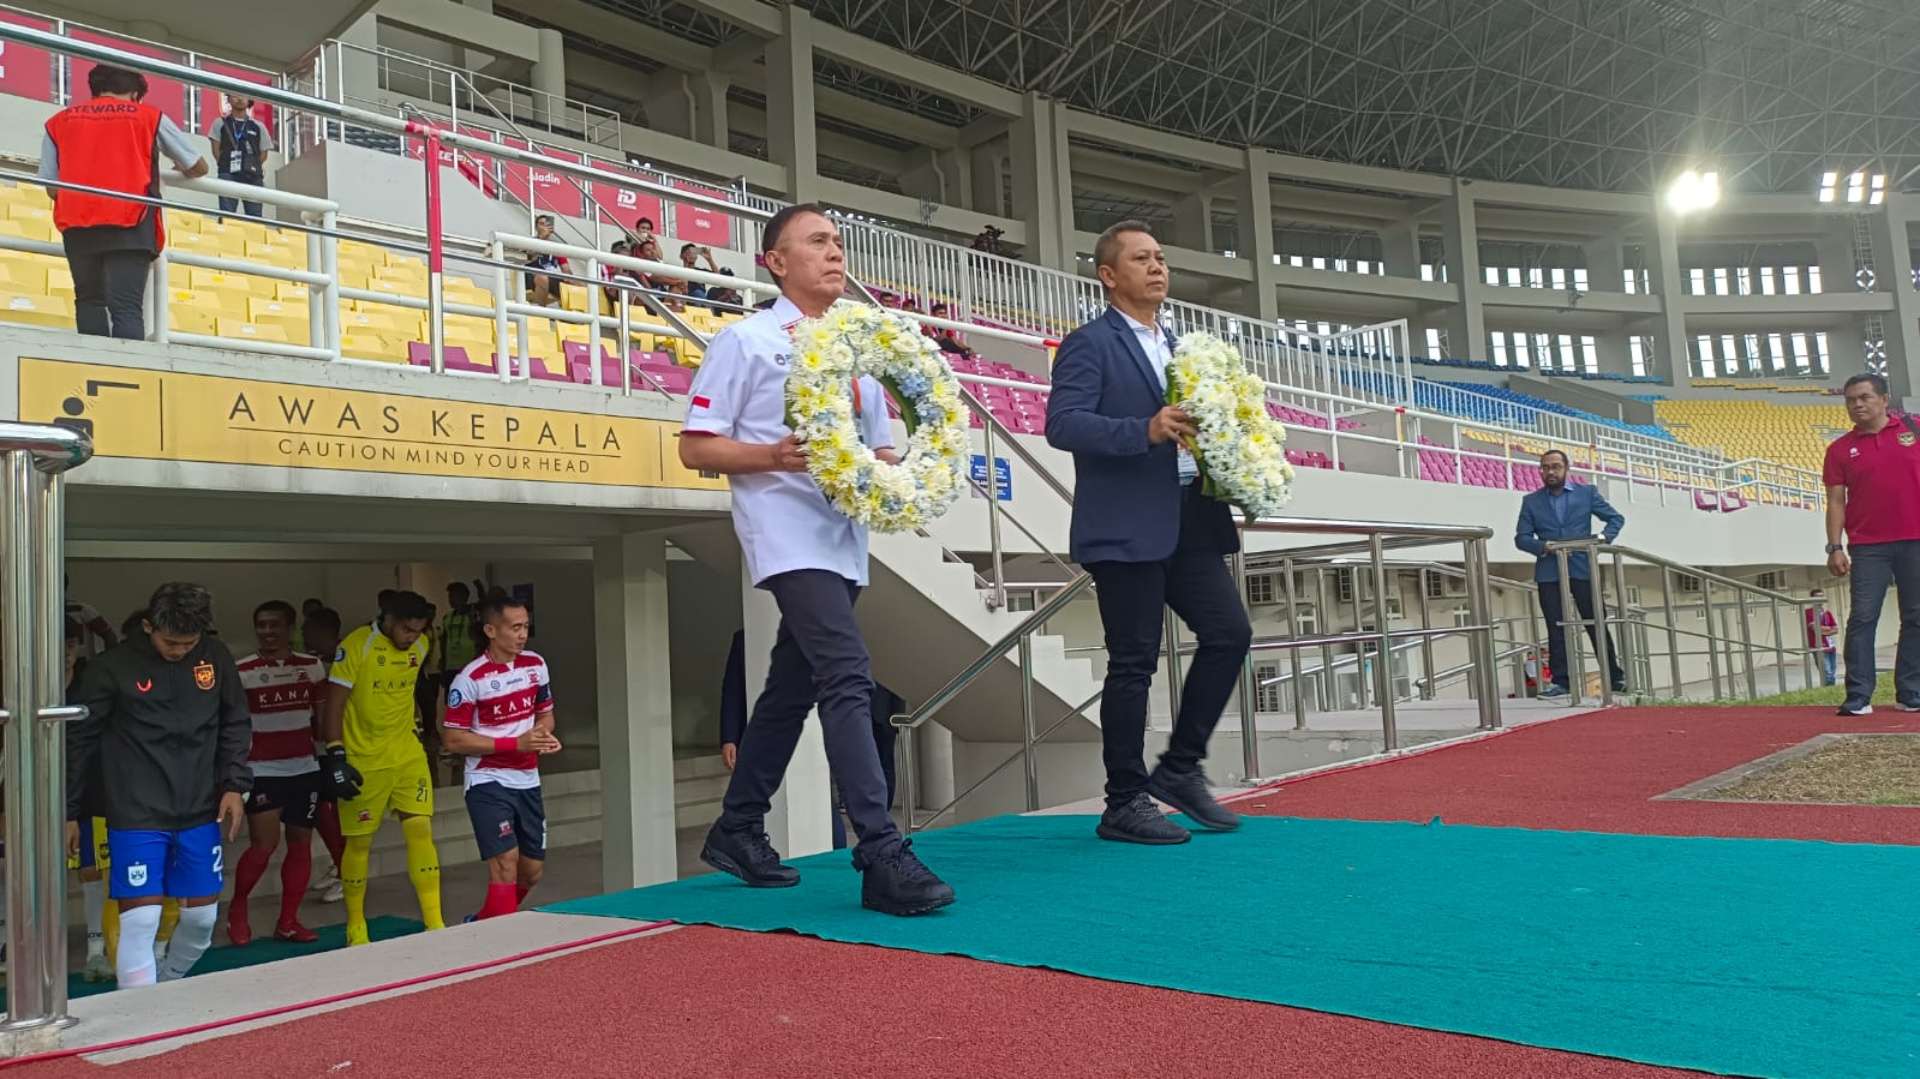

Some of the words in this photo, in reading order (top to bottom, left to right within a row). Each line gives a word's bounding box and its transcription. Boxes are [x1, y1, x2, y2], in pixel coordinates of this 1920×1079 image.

[228, 392, 400, 433] AWAS
[432, 410, 621, 450] KEPALA
[278, 438, 395, 461] CAUTION
[406, 449, 465, 466] MIND
[474, 453, 531, 470] YOUR
[539, 458, 590, 474] HEAD
[259, 688, 310, 703] KANA
[416, 787, 428, 803] 21
[306, 804, 316, 819] 2
